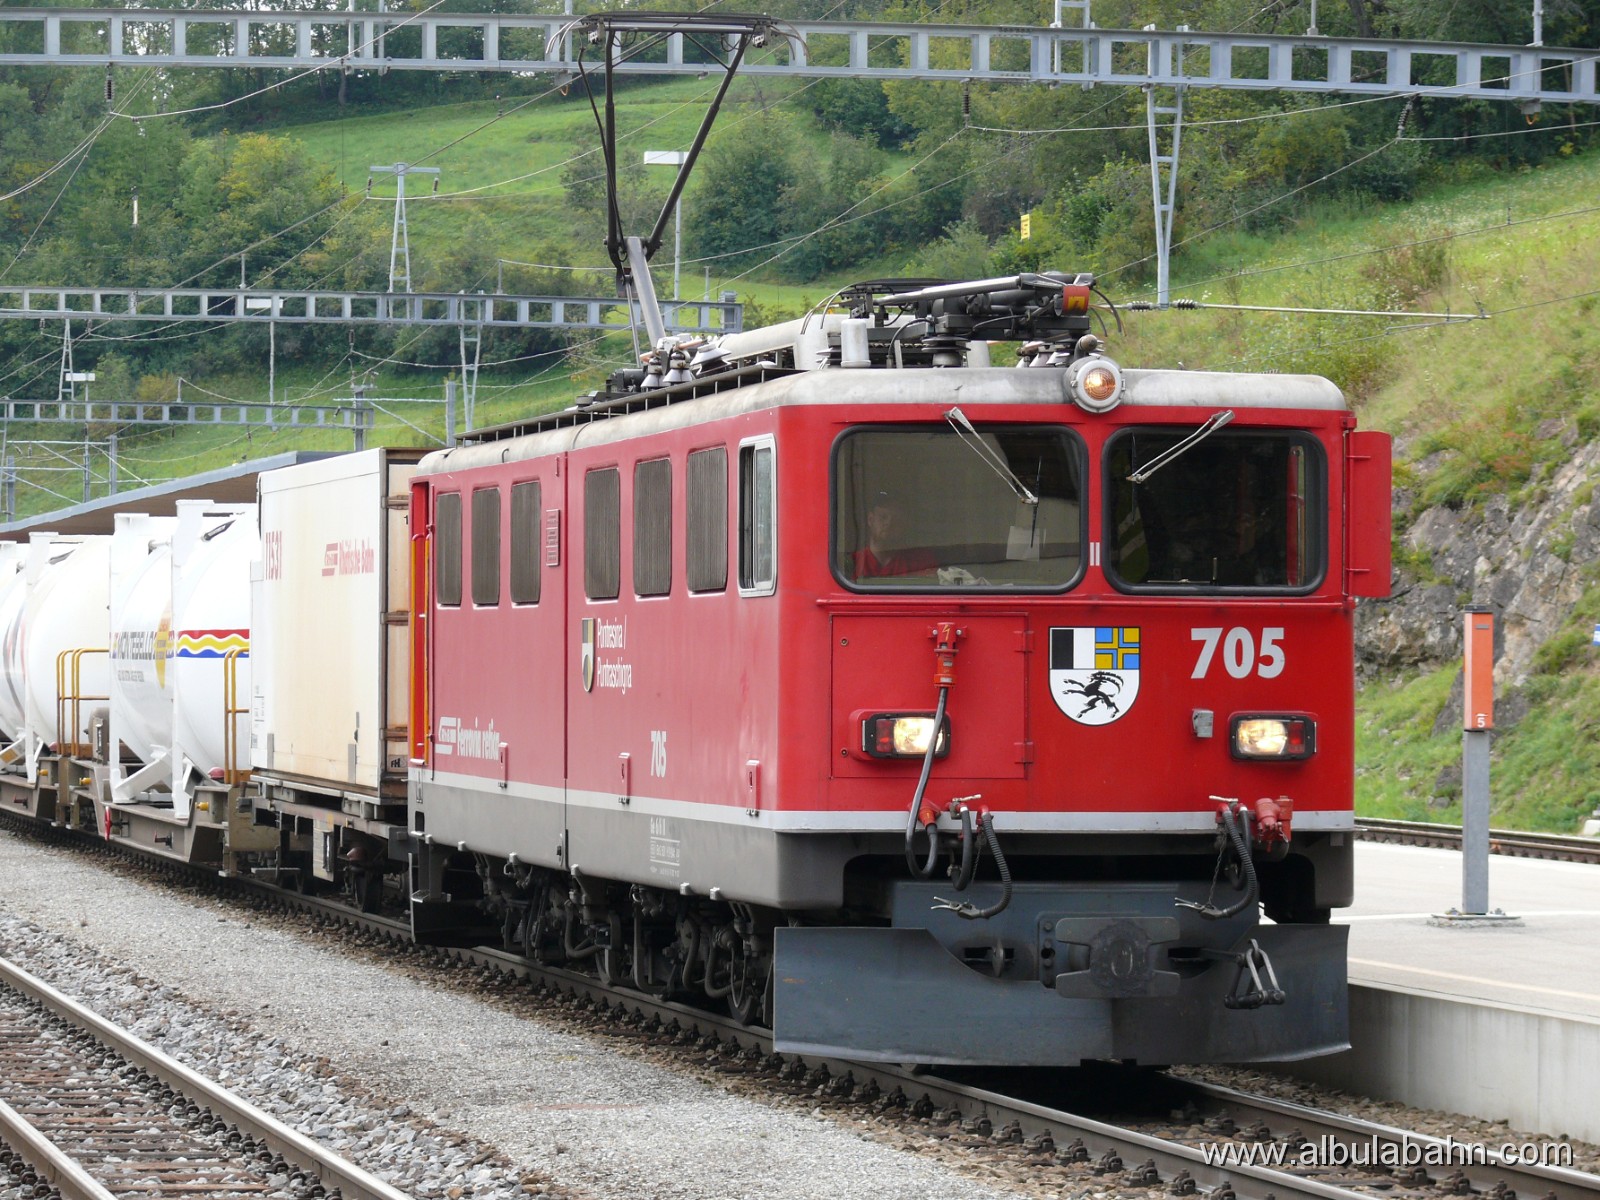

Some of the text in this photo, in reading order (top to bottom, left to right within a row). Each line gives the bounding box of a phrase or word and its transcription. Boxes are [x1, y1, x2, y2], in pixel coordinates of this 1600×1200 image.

[265, 531, 282, 580] 11531
[1190, 626, 1285, 679] 705
[1476, 717, 1486, 728] 5
[651, 730, 667, 777] 705
